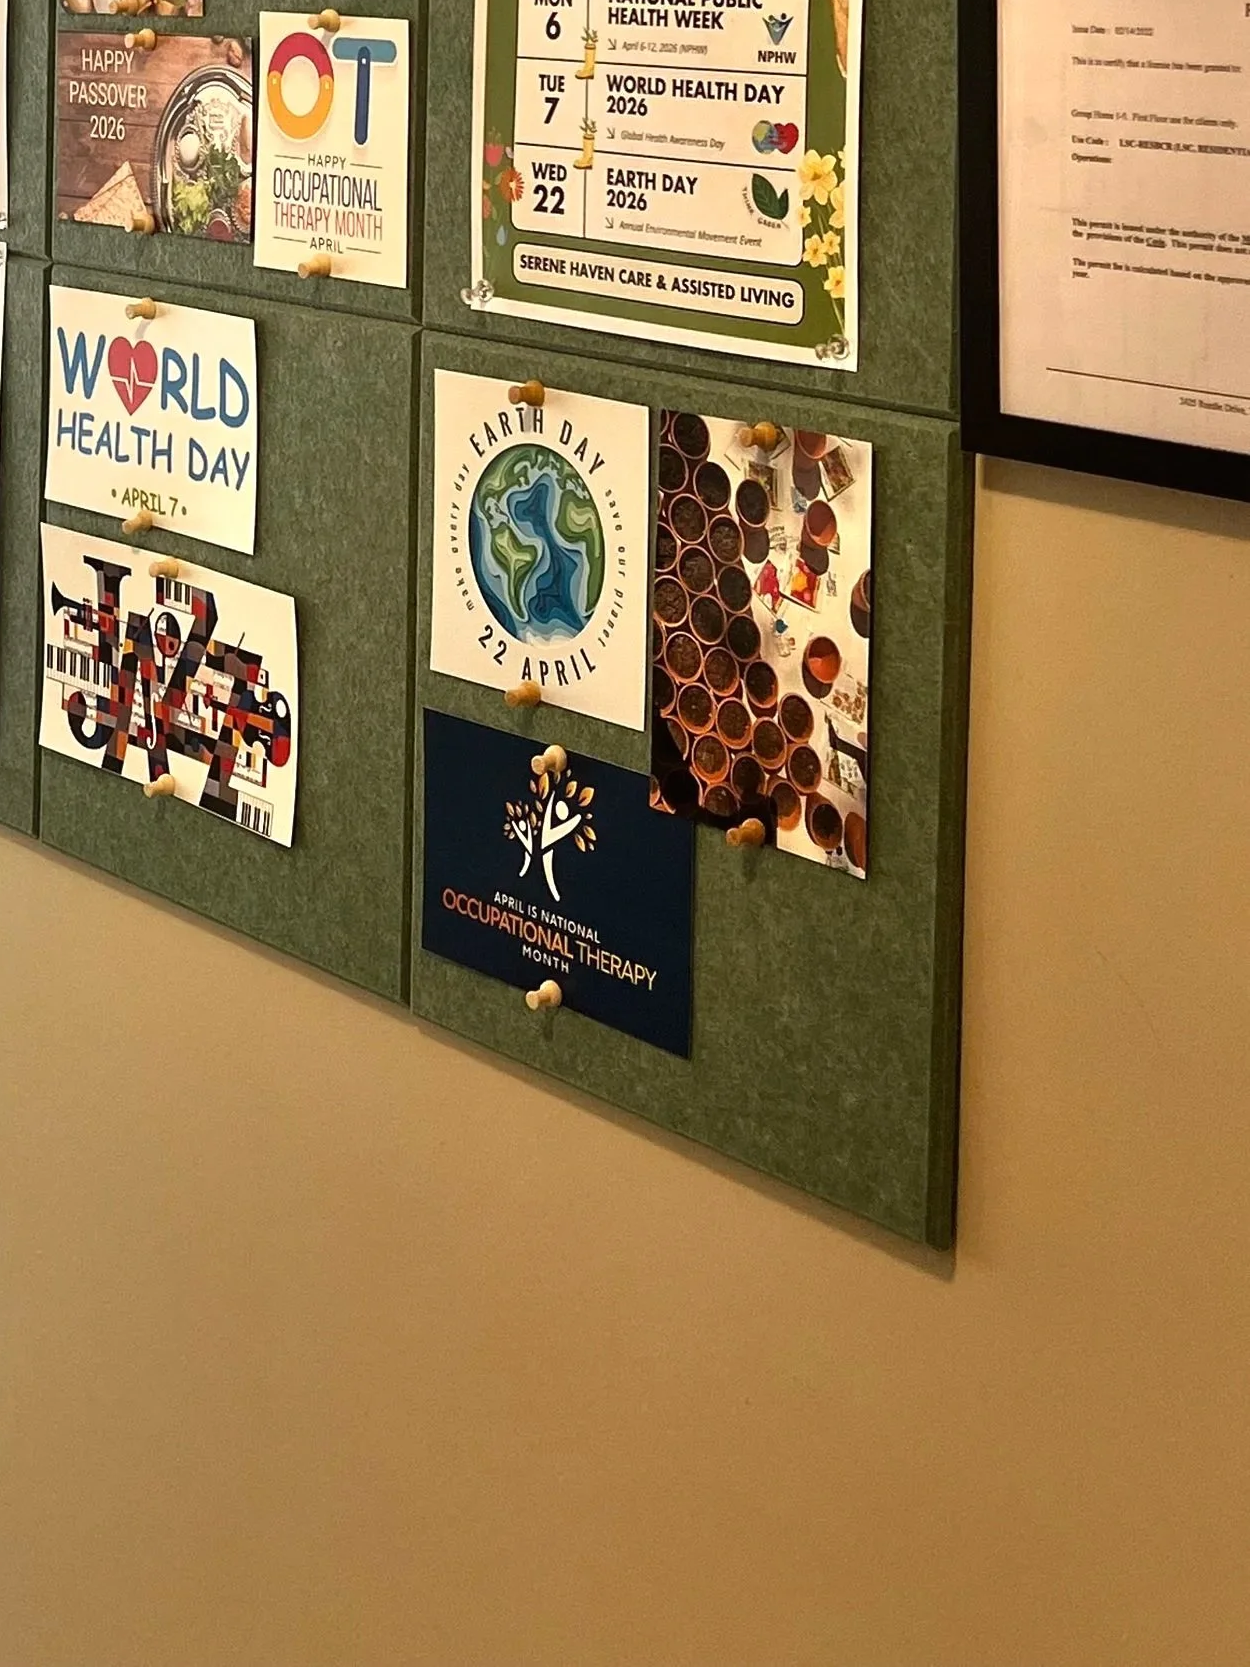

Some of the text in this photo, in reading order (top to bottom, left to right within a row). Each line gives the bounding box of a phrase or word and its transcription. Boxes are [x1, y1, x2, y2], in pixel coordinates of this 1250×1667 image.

[545, 11, 562, 41] 6
[607, 6, 725, 31] HEALTH WEEK
[81, 49, 134, 74] HAPPY
[757, 50, 797, 65] NPHW
[69, 80, 147, 109] PASSOVER
[266, 31, 398, 147] OT
[538, 73, 566, 125] TUE 7
[606, 74, 785, 105] WORLD HEALTH DAY
[606, 95, 649, 117] 2026
[89, 115, 126, 141] 2026
[669, 135, 708, 148] Awareness
[709, 138, 726, 151] Day
[307, 153, 347, 171] HAPPY
[272, 167, 383, 212] OCCUPATIONAL
[531, 161, 568, 215] WED 22
[606, 168, 698, 195] EARTH DAY
[606, 189, 648, 212] 2026
[273, 200, 384, 241] THERAPY MONTH
[309, 236, 344, 255] APRIL
[697, 230, 738, 245] Movement
[738, 234, 763, 248] Event
[519, 254, 796, 309] SERENE HAVEN CARE & ASSISTED LIVING
[56, 326, 250, 429] WORLD
[56, 407, 250, 492] HEALTH DAY
[468, 406, 606, 476] EARTH DAY
[121, 487, 179, 517] APRIL 7
[478, 624, 597, 687] 22 APRIL
[493, 890, 601, 945] APRIL IS NATIONAL
[442, 887, 658, 991] OCCUPATIONAL THERAPY
[522, 945, 570, 975] MONTH
